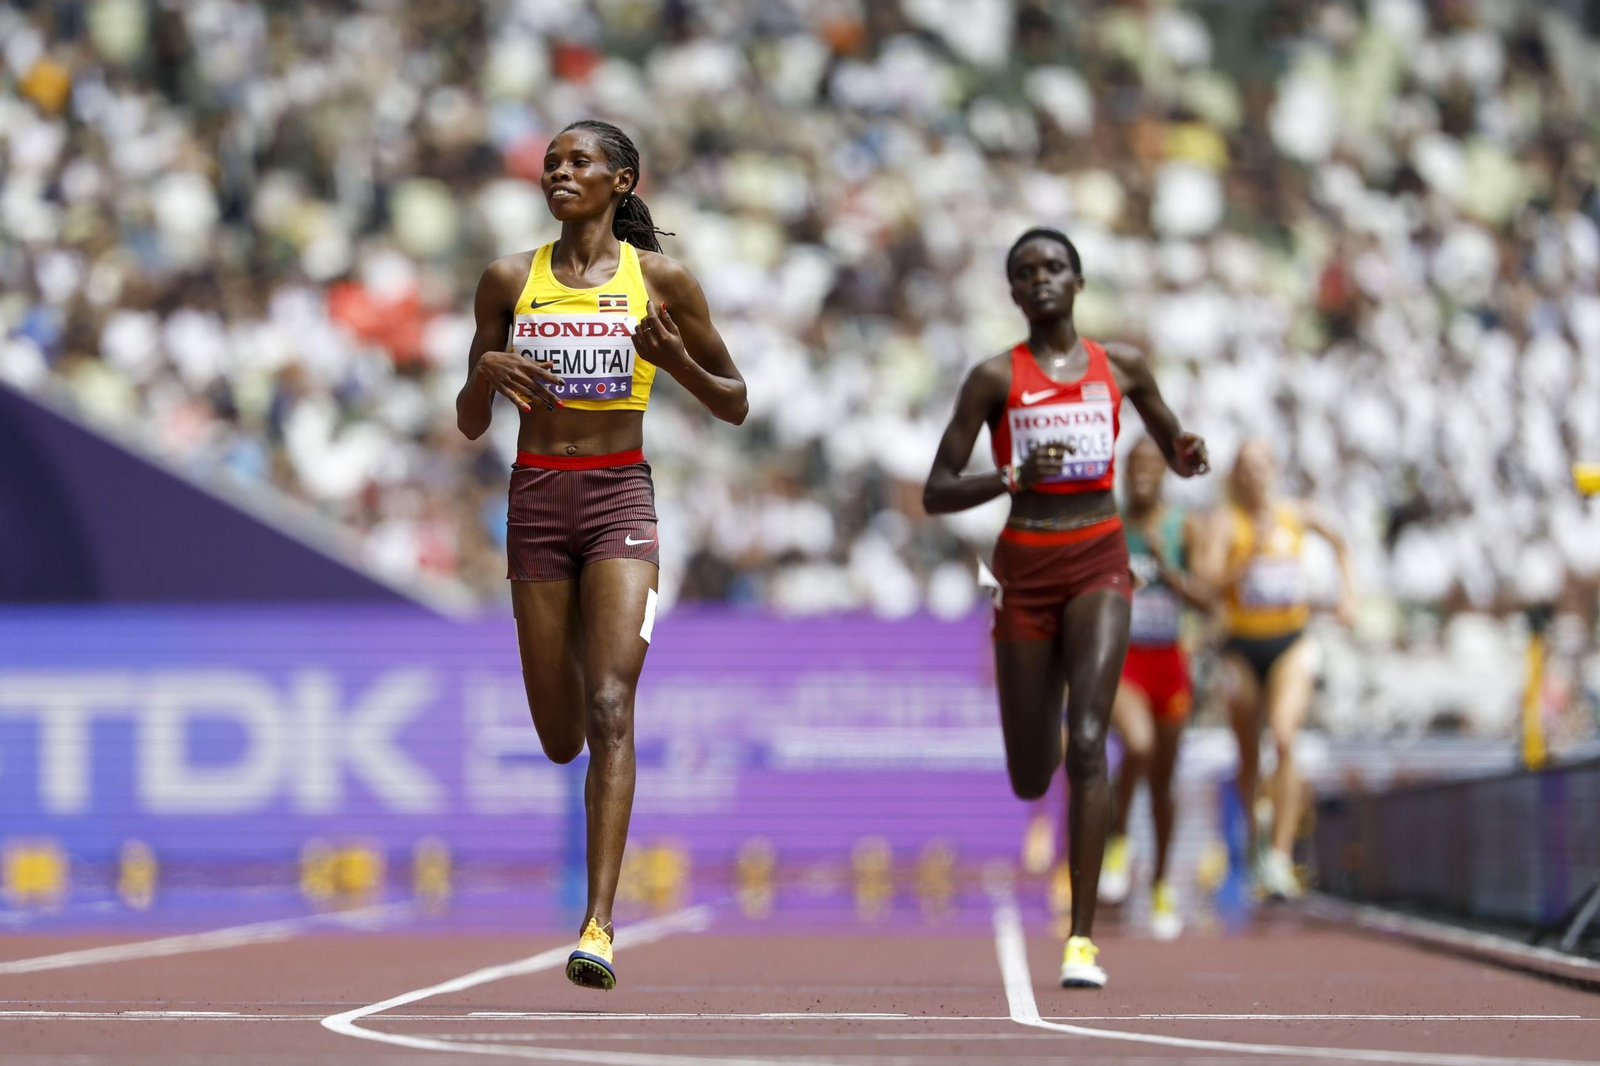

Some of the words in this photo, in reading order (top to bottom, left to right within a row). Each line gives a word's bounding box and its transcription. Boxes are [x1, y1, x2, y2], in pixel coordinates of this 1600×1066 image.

[516, 322, 632, 337] HONDA
[1013, 411, 1107, 430] HONDA
[0, 670, 440, 814] TDK
